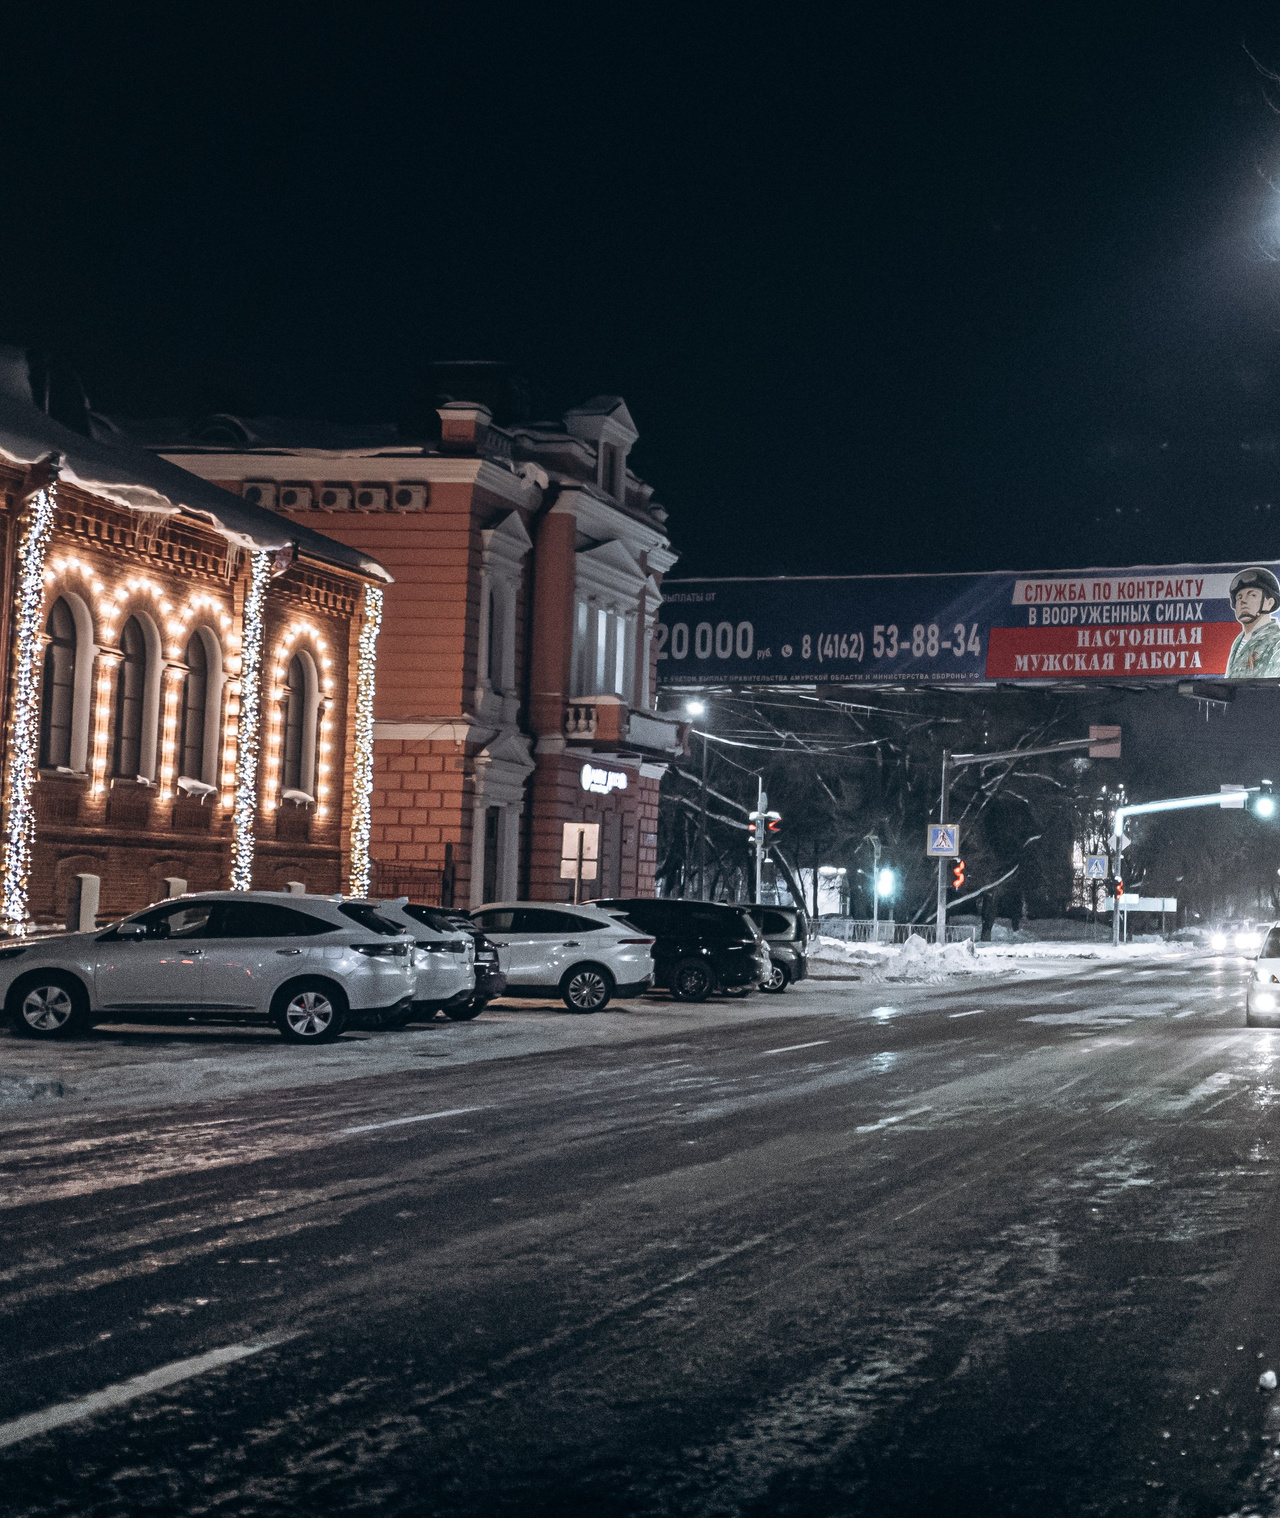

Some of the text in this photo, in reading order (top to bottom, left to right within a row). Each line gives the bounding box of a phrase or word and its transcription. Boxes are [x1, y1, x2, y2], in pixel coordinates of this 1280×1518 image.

[705, 592, 717, 602] ОТ
[1024, 579, 1204, 603] СЛУЖБА ПО КОНТРАКТУ
[1028, 602, 1204, 625] В ВООРУЖЕННЫХ СИЛАХ
[801, 622, 981, 663] 8 (4162) 53-88-34
[1076, 627, 1203, 648] НАСТОЯЩАЯ
[757, 647, 772, 661] руб.
[1014, 650, 1202, 672] МУЖСКАЯ РАБОТА
[729, 674, 788, 682] ПРАВИТЕЛЬСТВА
[790, 673, 828, 681] АМУРСКОЙ
[830, 673, 863, 681] ОБЛАСТИ
[931, 672, 967, 680] ОБОРОНЫ
